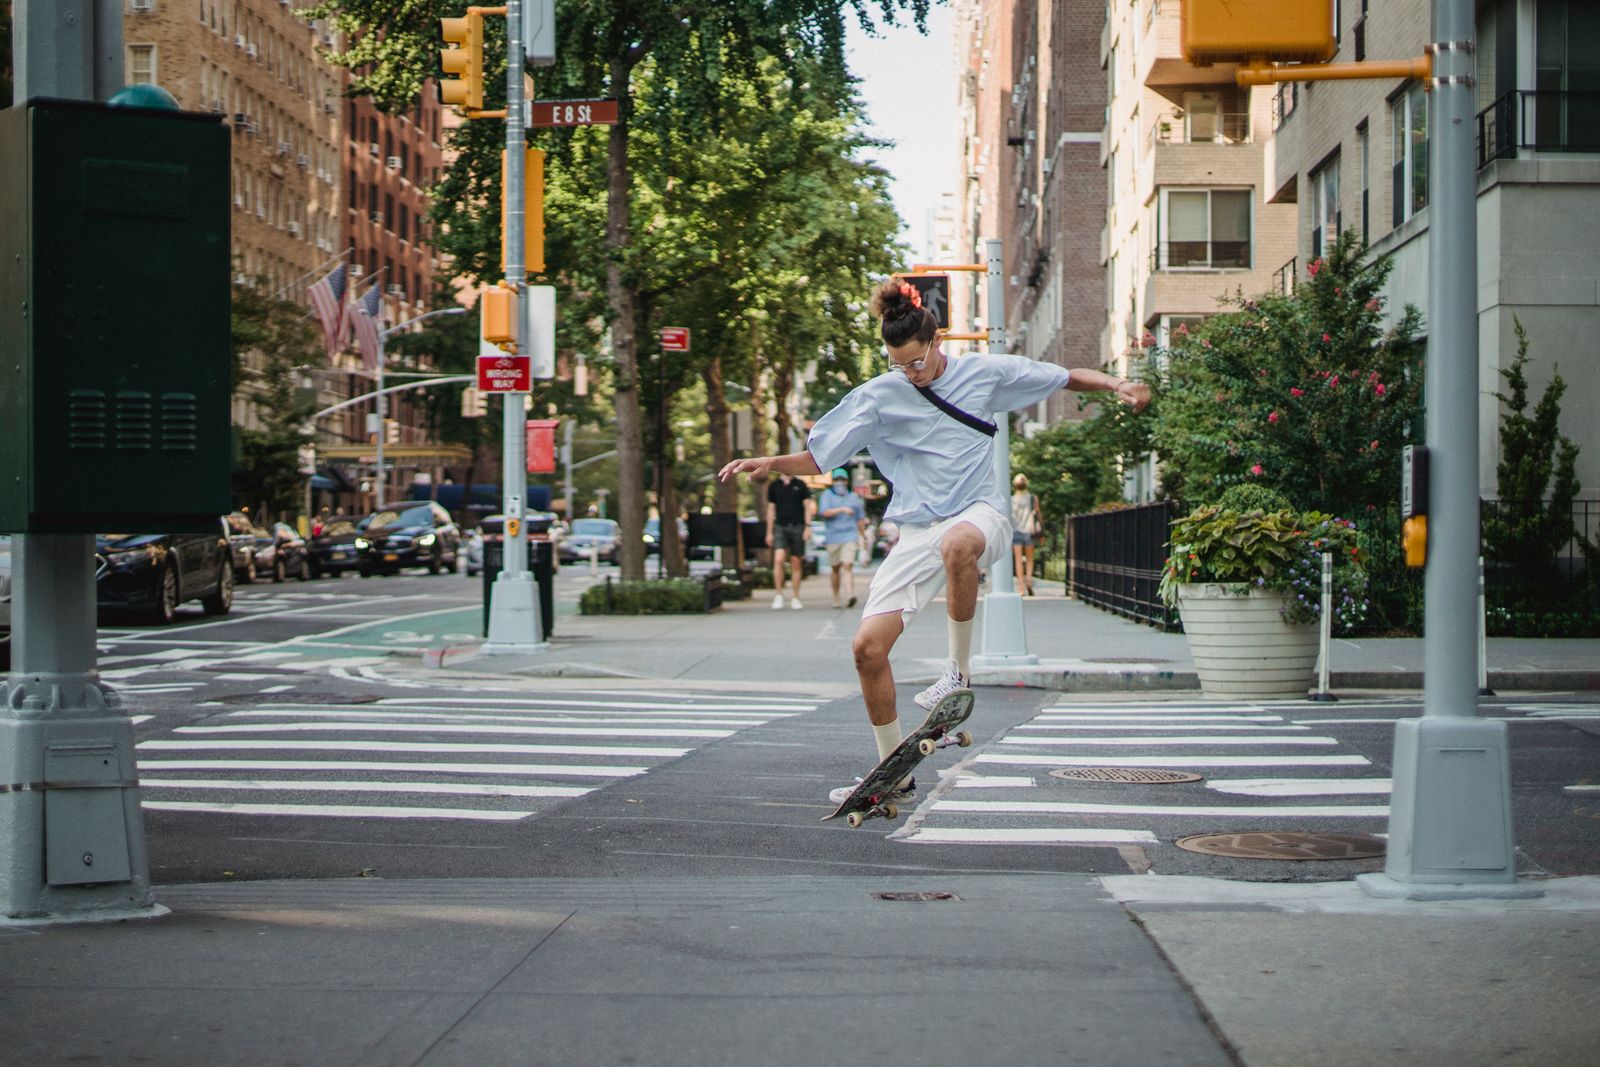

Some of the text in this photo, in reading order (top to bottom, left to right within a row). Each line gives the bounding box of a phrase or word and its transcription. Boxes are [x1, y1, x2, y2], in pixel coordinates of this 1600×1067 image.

[552, 104, 592, 123] E 8 St
[486, 369, 523, 379] WRONG
[492, 379, 516, 389] WAY
